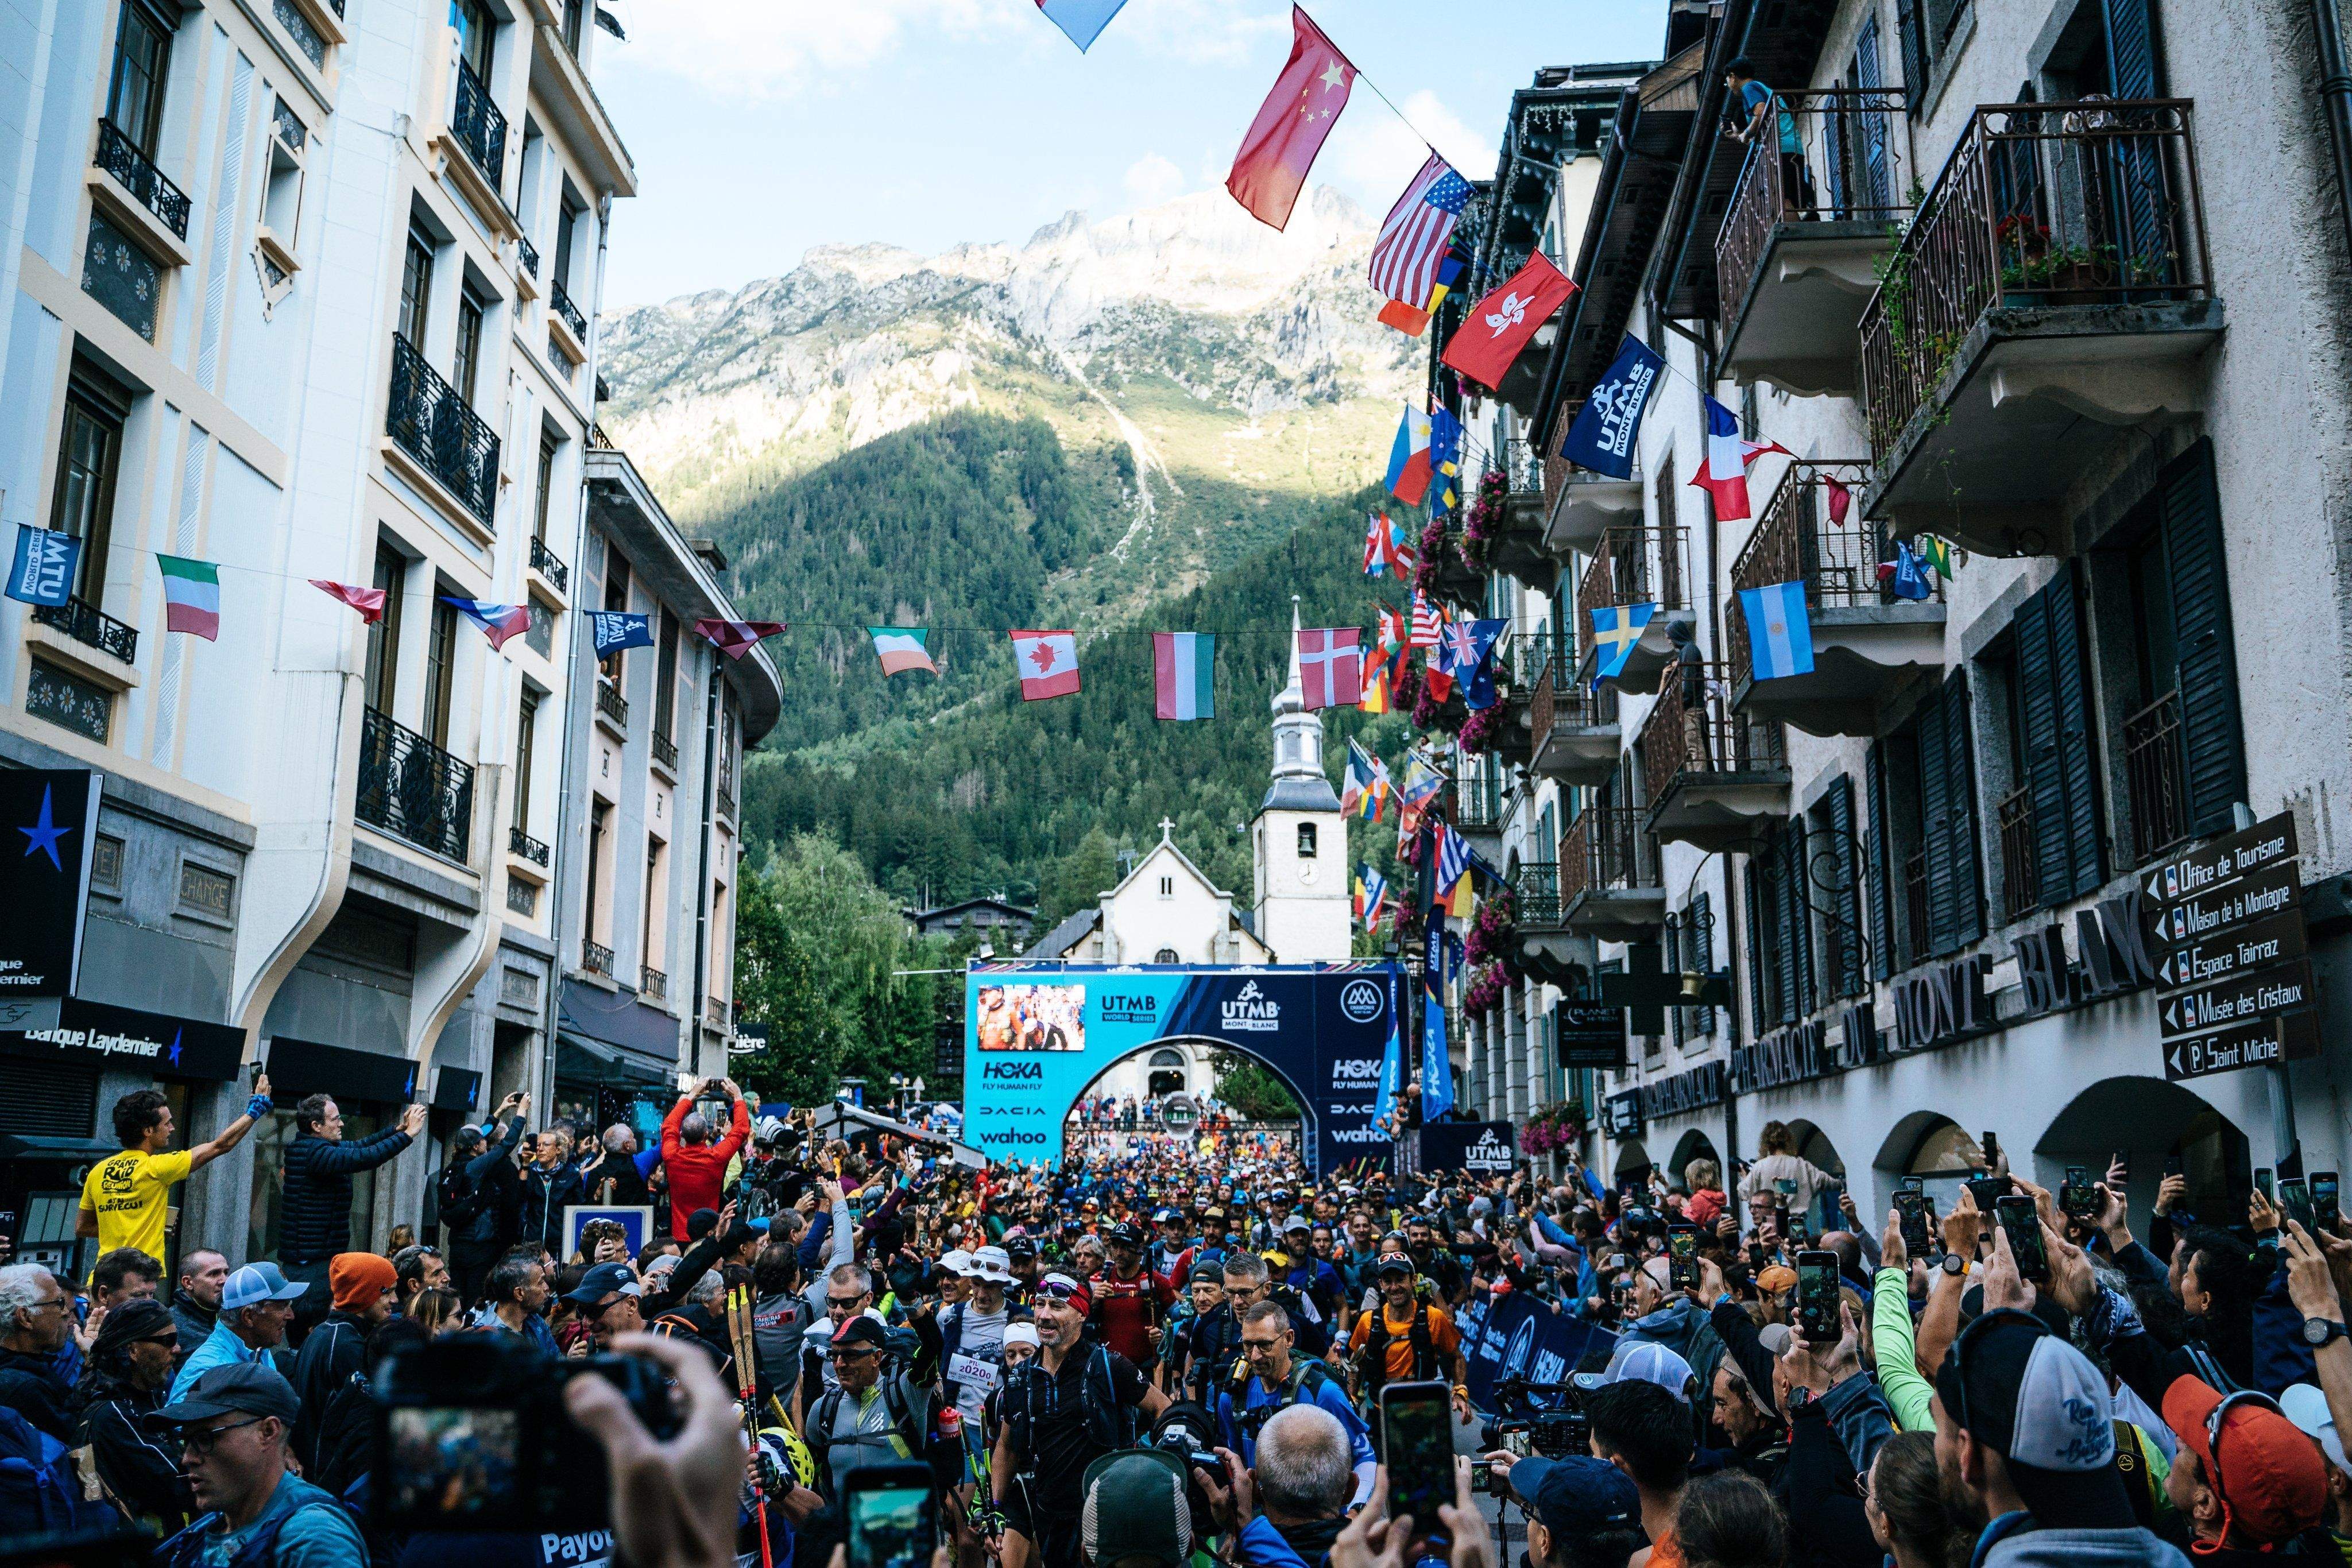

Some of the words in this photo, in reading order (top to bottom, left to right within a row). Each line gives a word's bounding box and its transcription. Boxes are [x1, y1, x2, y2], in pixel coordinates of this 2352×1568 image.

[1597, 363, 1643, 451] UTMB
[2180, 860, 2214, 892] Office
[2218, 855, 2231, 877] de
[2235, 837, 2285, 870] Tourisme
[2187, 904, 2219, 935] Maison
[2222, 905, 2233, 924] de
[2235, 901, 2243, 919] la
[2246, 884, 2290, 916] Montagne
[2192, 947, 2233, 979] Espace
[2237, 939, 2278, 966] Tairraz
[1102, 996, 1156, 1011] UTMB
[1222, 1001, 1278, 1019] UTMB
[1842, 1004, 1874, 1069] DU
[1896, 954, 1993, 1051] MONT
[2198, 991, 2234, 1024] Musée
[2237, 996, 2255, 1015] des
[2258, 984, 2303, 1011] Cristaux
[1104, 1013, 1130, 1021] WORLD
[1132, 1015, 1155, 1023] SERIES
[87, 1028, 163, 1058] Laydernier
[2192, 1045, 2200, 1070] P
[2207, 1037, 2238, 1070] Saint
[2243, 1037, 2278, 1064] Miche
[984, 1062, 1043, 1079] HOKA
[1332, 1059, 1383, 1078] HOK
[980, 1106, 1046, 1115] DACIA
[980, 1127, 1047, 1144] wahoo
[1465, 1145, 1511, 1160] UTMB
[107, 1159, 139, 1168] GRAND
